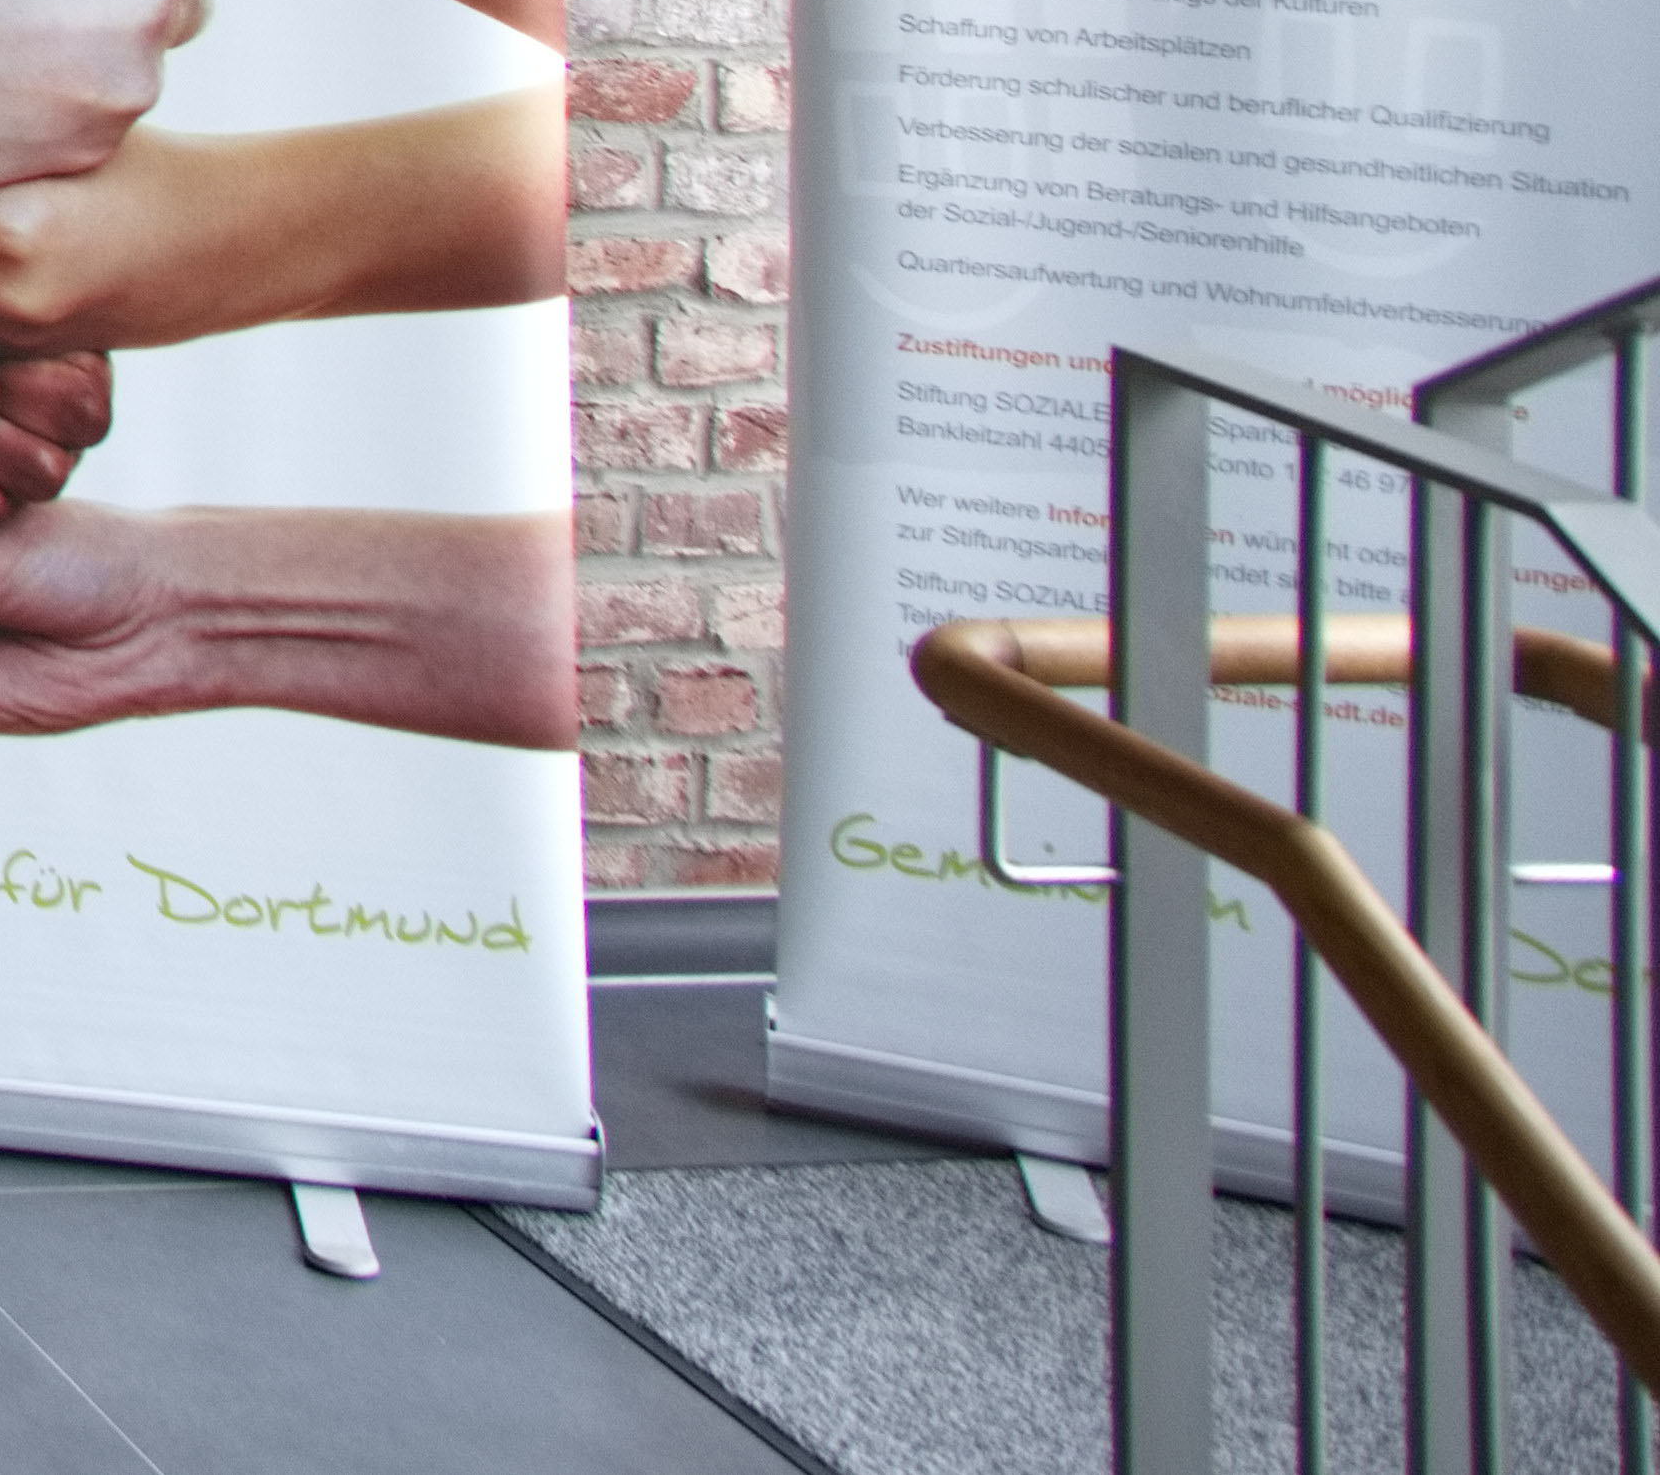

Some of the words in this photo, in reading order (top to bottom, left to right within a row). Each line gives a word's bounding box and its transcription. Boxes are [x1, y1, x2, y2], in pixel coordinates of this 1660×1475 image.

[899, 14, 1018, 44] Schaffung
[1026, 28, 1069, 45] von
[1075, 28, 1251, 60] Arbeitsplätzen
[899, 65, 1021, 96] Förderung
[1029, 78, 1164, 105] schulischer
[1174, 90, 1220, 111] und
[1228, 95, 1361, 122] beruflicher
[1369, 105, 1551, 143] Qualifizierung
[898, 117, 1064, 152] Verbesserung
[1071, 133, 1110, 153] der
[1119, 139, 1220, 165] sozialen
[1228, 149, 1276, 169] und
[1284, 153, 1503, 191] gesundheitlichen
[1511, 171, 1630, 202] Situation
[897, 201, 934, 220] der
[898, 165, 1028, 197] Ergänzung
[1034, 181, 1079, 200] von
[1087, 182, 1224, 213] Beratungs-
[1231, 199, 1278, 219] und
[1286, 200, 1481, 238] Hilfsangeboten
[897, 251, 1144, 297] Quartiersaufwertung
[1151, 279, 1197, 299] und
[897, 333, 1060, 369] Zustiftungen
[897, 382, 988, 413] Stiftung
[897, 416, 1042, 452] Bankleitzahl
[896, 485, 945, 510] Wer
[954, 495, 1041, 520] weitere
[897, 526, 934, 543] zur
[1338, 578, 1391, 602] bitte
[897, 568, 988, 603] Stiftung
[125, 853, 533, 955] Dortmund
